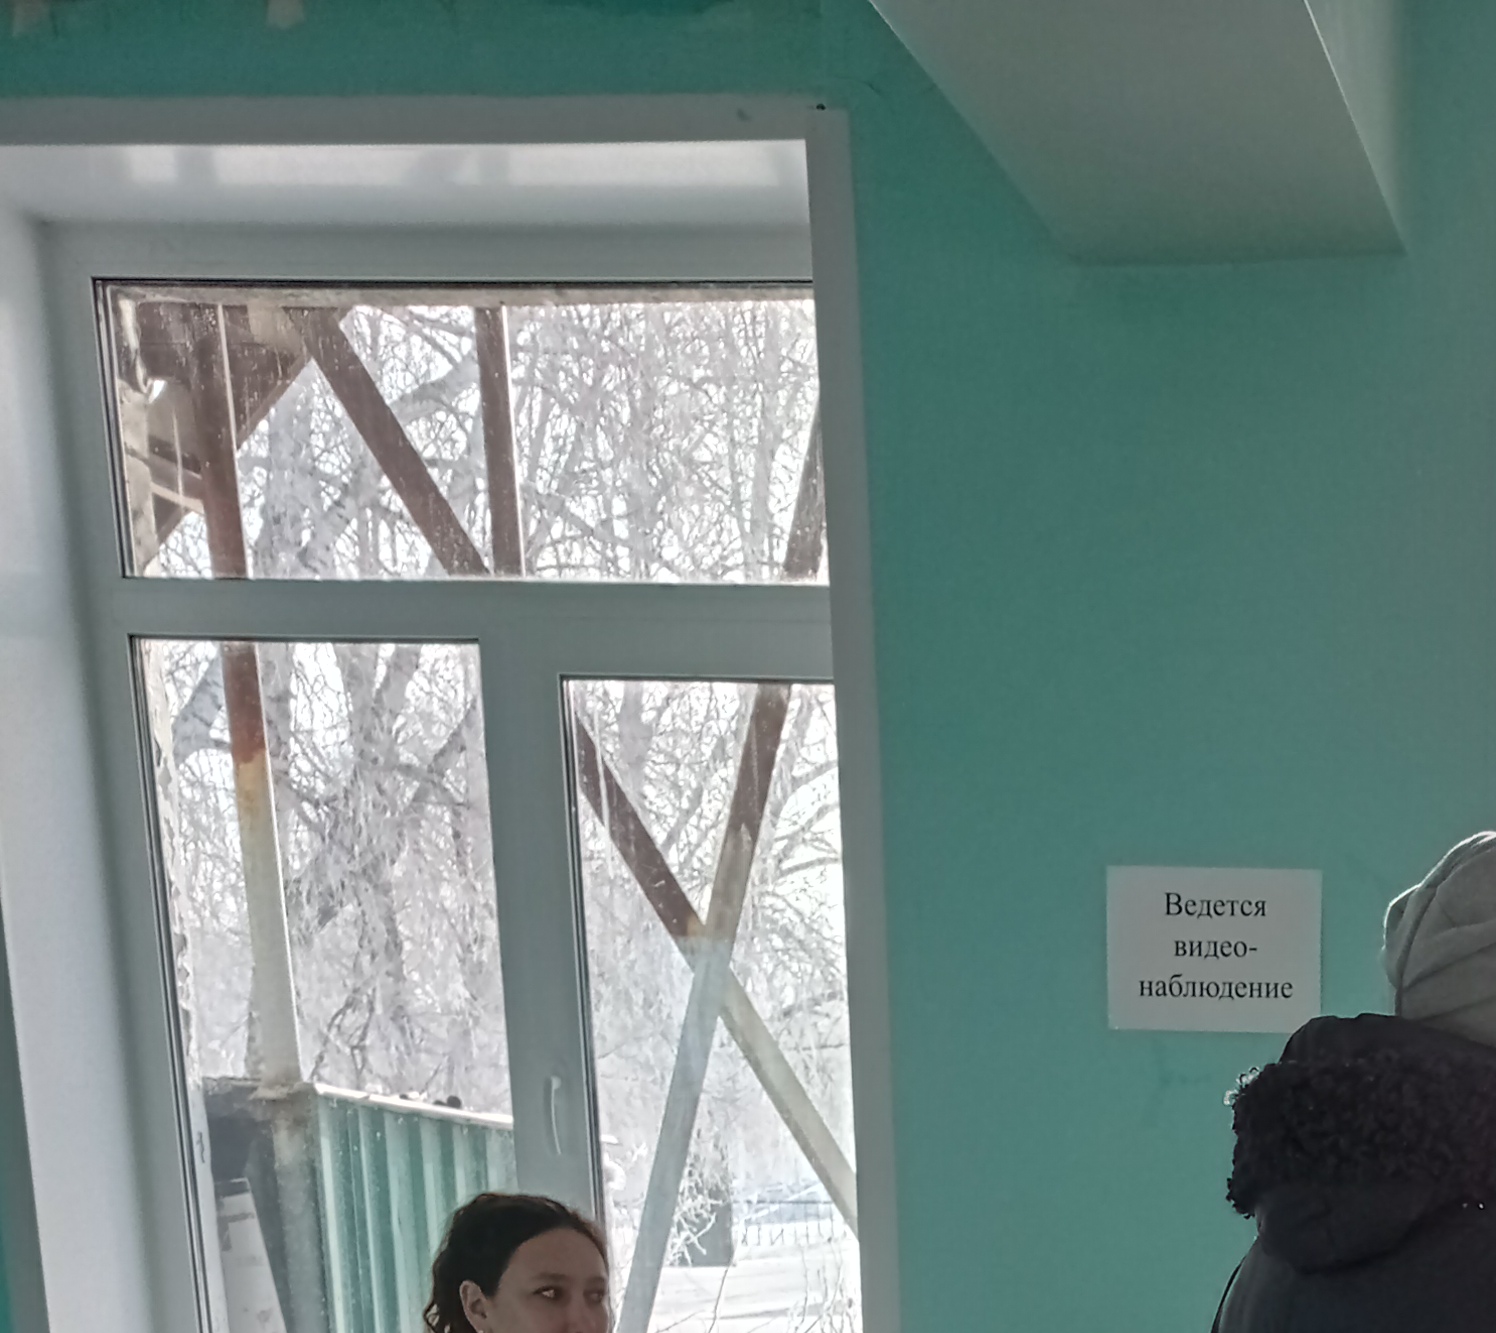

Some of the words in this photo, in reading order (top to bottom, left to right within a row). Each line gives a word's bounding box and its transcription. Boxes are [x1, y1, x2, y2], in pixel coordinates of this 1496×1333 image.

[1164, 892, 1267, 919] Ведется
[1173, 940, 1258, 960] видео-
[1138, 974, 1294, 1000] наблюдение
